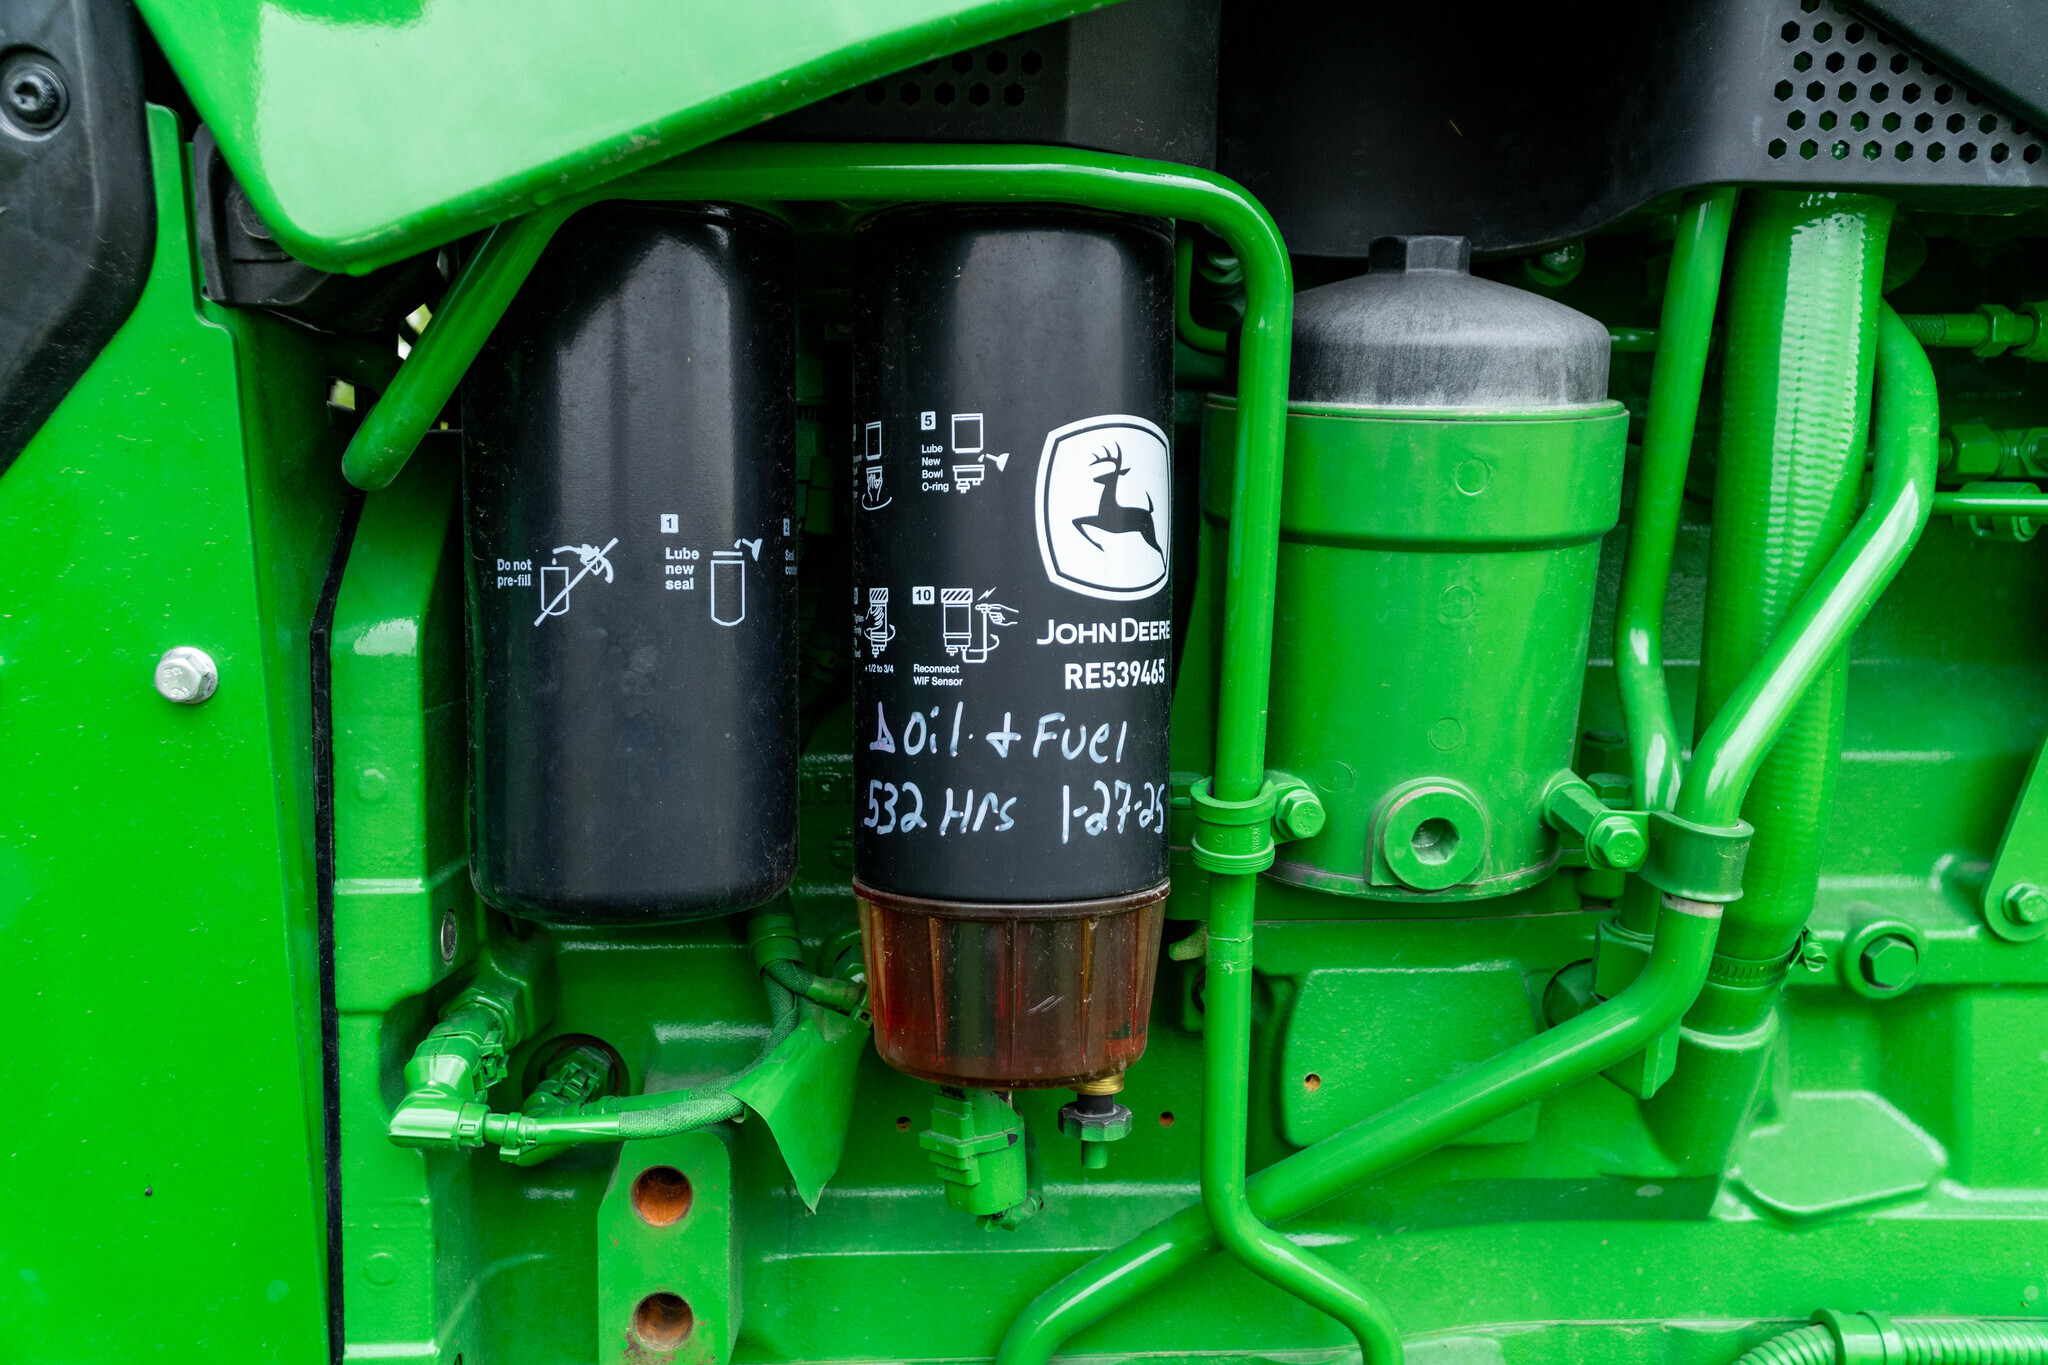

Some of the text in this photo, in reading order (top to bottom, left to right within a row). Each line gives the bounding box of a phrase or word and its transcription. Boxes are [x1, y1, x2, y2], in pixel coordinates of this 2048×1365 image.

[921, 443, 944, 454] Lube
[921, 456, 941, 466] New
[921, 469, 944, 479] Bowl
[921, 481, 949, 493] O-ring
[665, 547, 700, 561] Lube
[497, 558, 533, 572] Do not
[665, 564, 695, 575] new
[497, 573, 532, 588] pre-fill
[665, 578, 695, 591] seal
[915, 589, 932, 602] 10
[1036, 617, 1171, 645] JOHN DEERE
[876, 664, 884, 673] to
[883, 664, 894, 674] 3/4
[913, 663, 960, 674] Reconnect
[1064, 658, 1165, 690] RE539465
[913, 675, 964, 687] WIF Sensor
[1032, 712, 1128, 764] Fuel
[864, 779, 928, 835] 532
[939, 787, 1018, 837] Hrs
[1061, 779, 1165, 845] 1-27-25
